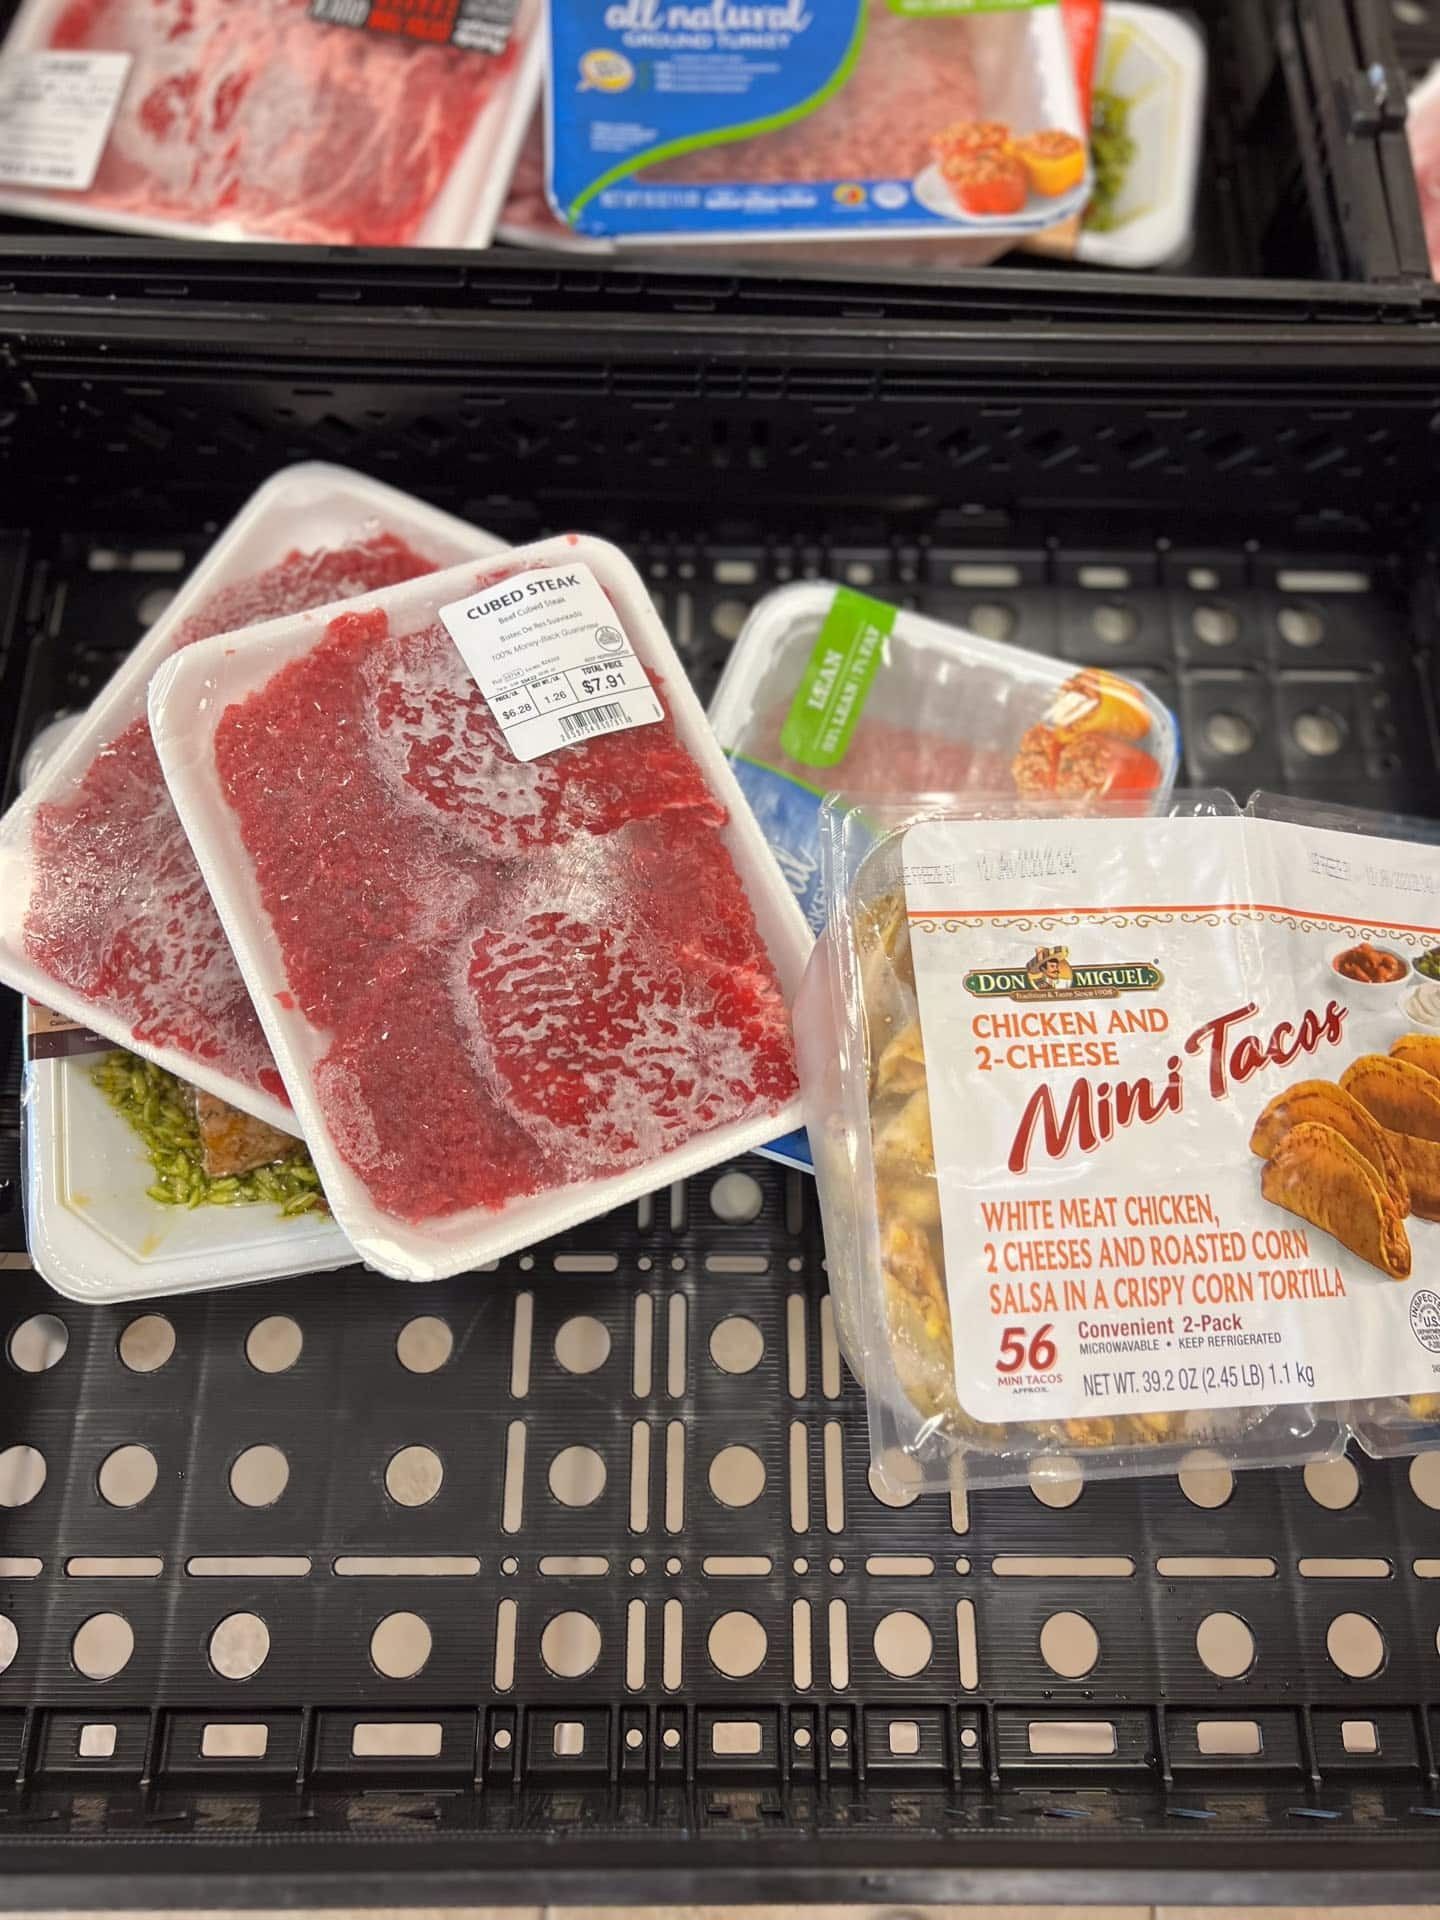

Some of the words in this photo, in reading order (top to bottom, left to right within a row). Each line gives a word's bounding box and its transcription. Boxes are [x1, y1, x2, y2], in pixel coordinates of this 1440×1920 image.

[717, 31, 791, 48] TURKEY
[466, 589, 524, 620] CUBED
[526, 574, 580, 596] STEAK
[498, 613, 517, 624] Beef
[517, 602, 544, 616] Cubed
[543, 597, 566, 608] Steak
[581, 662, 604, 675] TOTAL
[603, 659, 624, 671] PRICE
[807, 648, 844, 711] LEAN
[544, 690, 567, 704] 1.26
[581, 672, 627, 695] $7.91
[502, 703, 532, 721] $6.28
[831, 681, 859, 727] LEAN
[977, 973, 1025, 992] DON
[1075, 967, 1150, 987] MIGUEL
[971, 1011, 1100, 1038] CHICKEN
[1107, 1007, 1169, 1034] AND
[974, 1041, 1120, 1072] 2-CHEESE
[1184, 1000, 1348, 1099] Tacos
[1008, 1055, 1184, 1175] Mini
[980, 1200, 1054, 1232] WHITE
[1059, 1197, 1117, 1229] MEAT
[1124, 1194, 1220, 1228] CHICKEN,
[984, 1242, 998, 1273] 2
[1003, 1238, 1093, 1272] CHEESES
[1099, 1235, 1146, 1268] AND
[1149, 1232, 1246, 1266] ROASTED
[1251, 1229, 1311, 1260] CORN
[989, 1279, 1058, 1315] SALSA
[1064, 1278, 1087, 1311] IN
[1094, 1277, 1109, 1309] A
[1113, 1275, 1185, 1308] CRISPY
[1192, 1271, 1254, 1304] CORN
[1258, 1267, 1346, 1301] TORTILLA
[1078, 1317, 1174, 1339] Convenient
[1183, 1313, 1243, 1334] 2-Pack
[995, 1323, 1058, 1373] 56
[1079, 1339, 1160, 1355] MICROWAVABLE
[1178, 1335, 1204, 1349] KEEP
[1208, 1332, 1282, 1348] REFRIGERATED
[998, 1376, 1023, 1387] MINI
[1025, 1373, 1063, 1385] TACOS
[1083, 1374, 1109, 1396] NET
[1112, 1371, 1139, 1395] WT.
[1142, 1368, 1175, 1393] 39.2
[1178, 1367, 1198, 1390] OZ
[1202, 1365, 1238, 1393] (2.45
[1242, 1363, 1265, 1390] LB)
[1269, 1362, 1291, 1385] 1.1
[1297, 1361, 1315, 1387] kg
